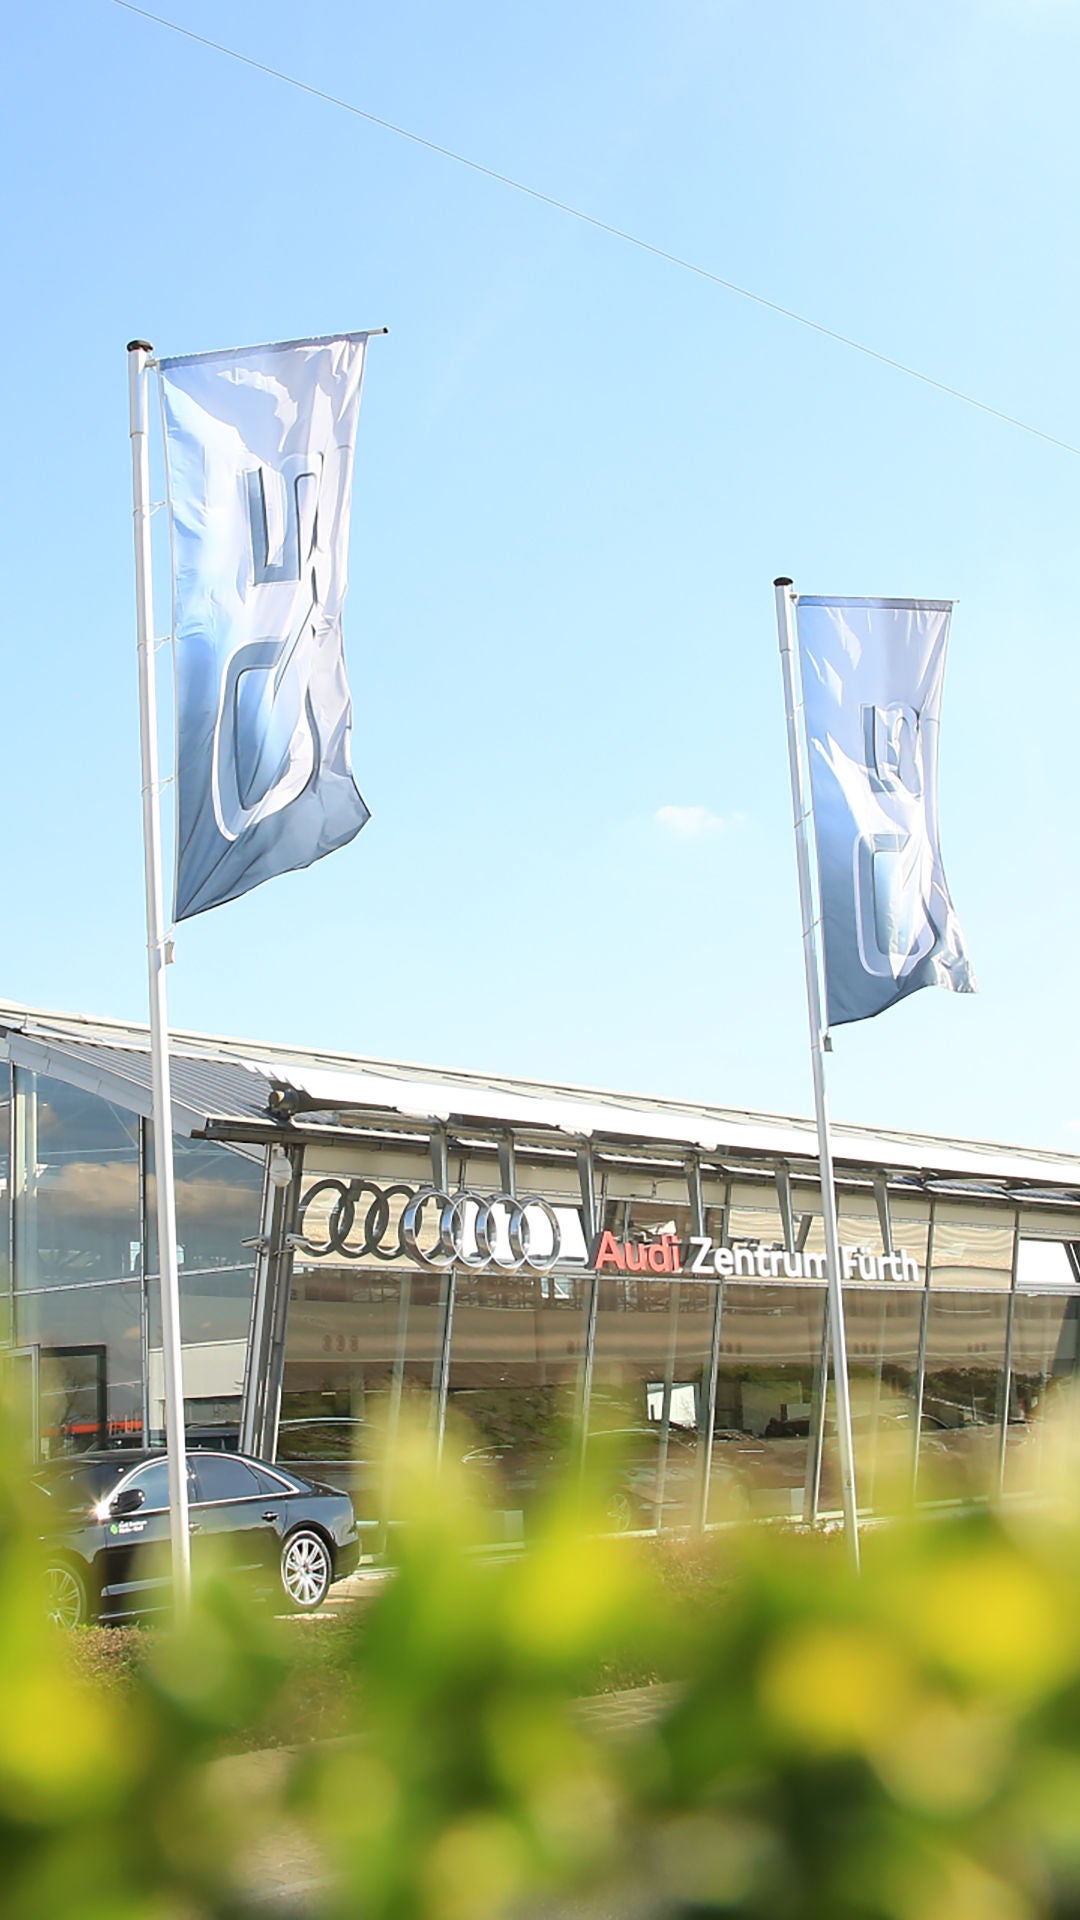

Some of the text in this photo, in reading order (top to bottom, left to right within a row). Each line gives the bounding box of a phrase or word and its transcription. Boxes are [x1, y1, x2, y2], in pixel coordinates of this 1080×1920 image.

[594, 1230, 920, 1282] Audi Zentrum Fürth
